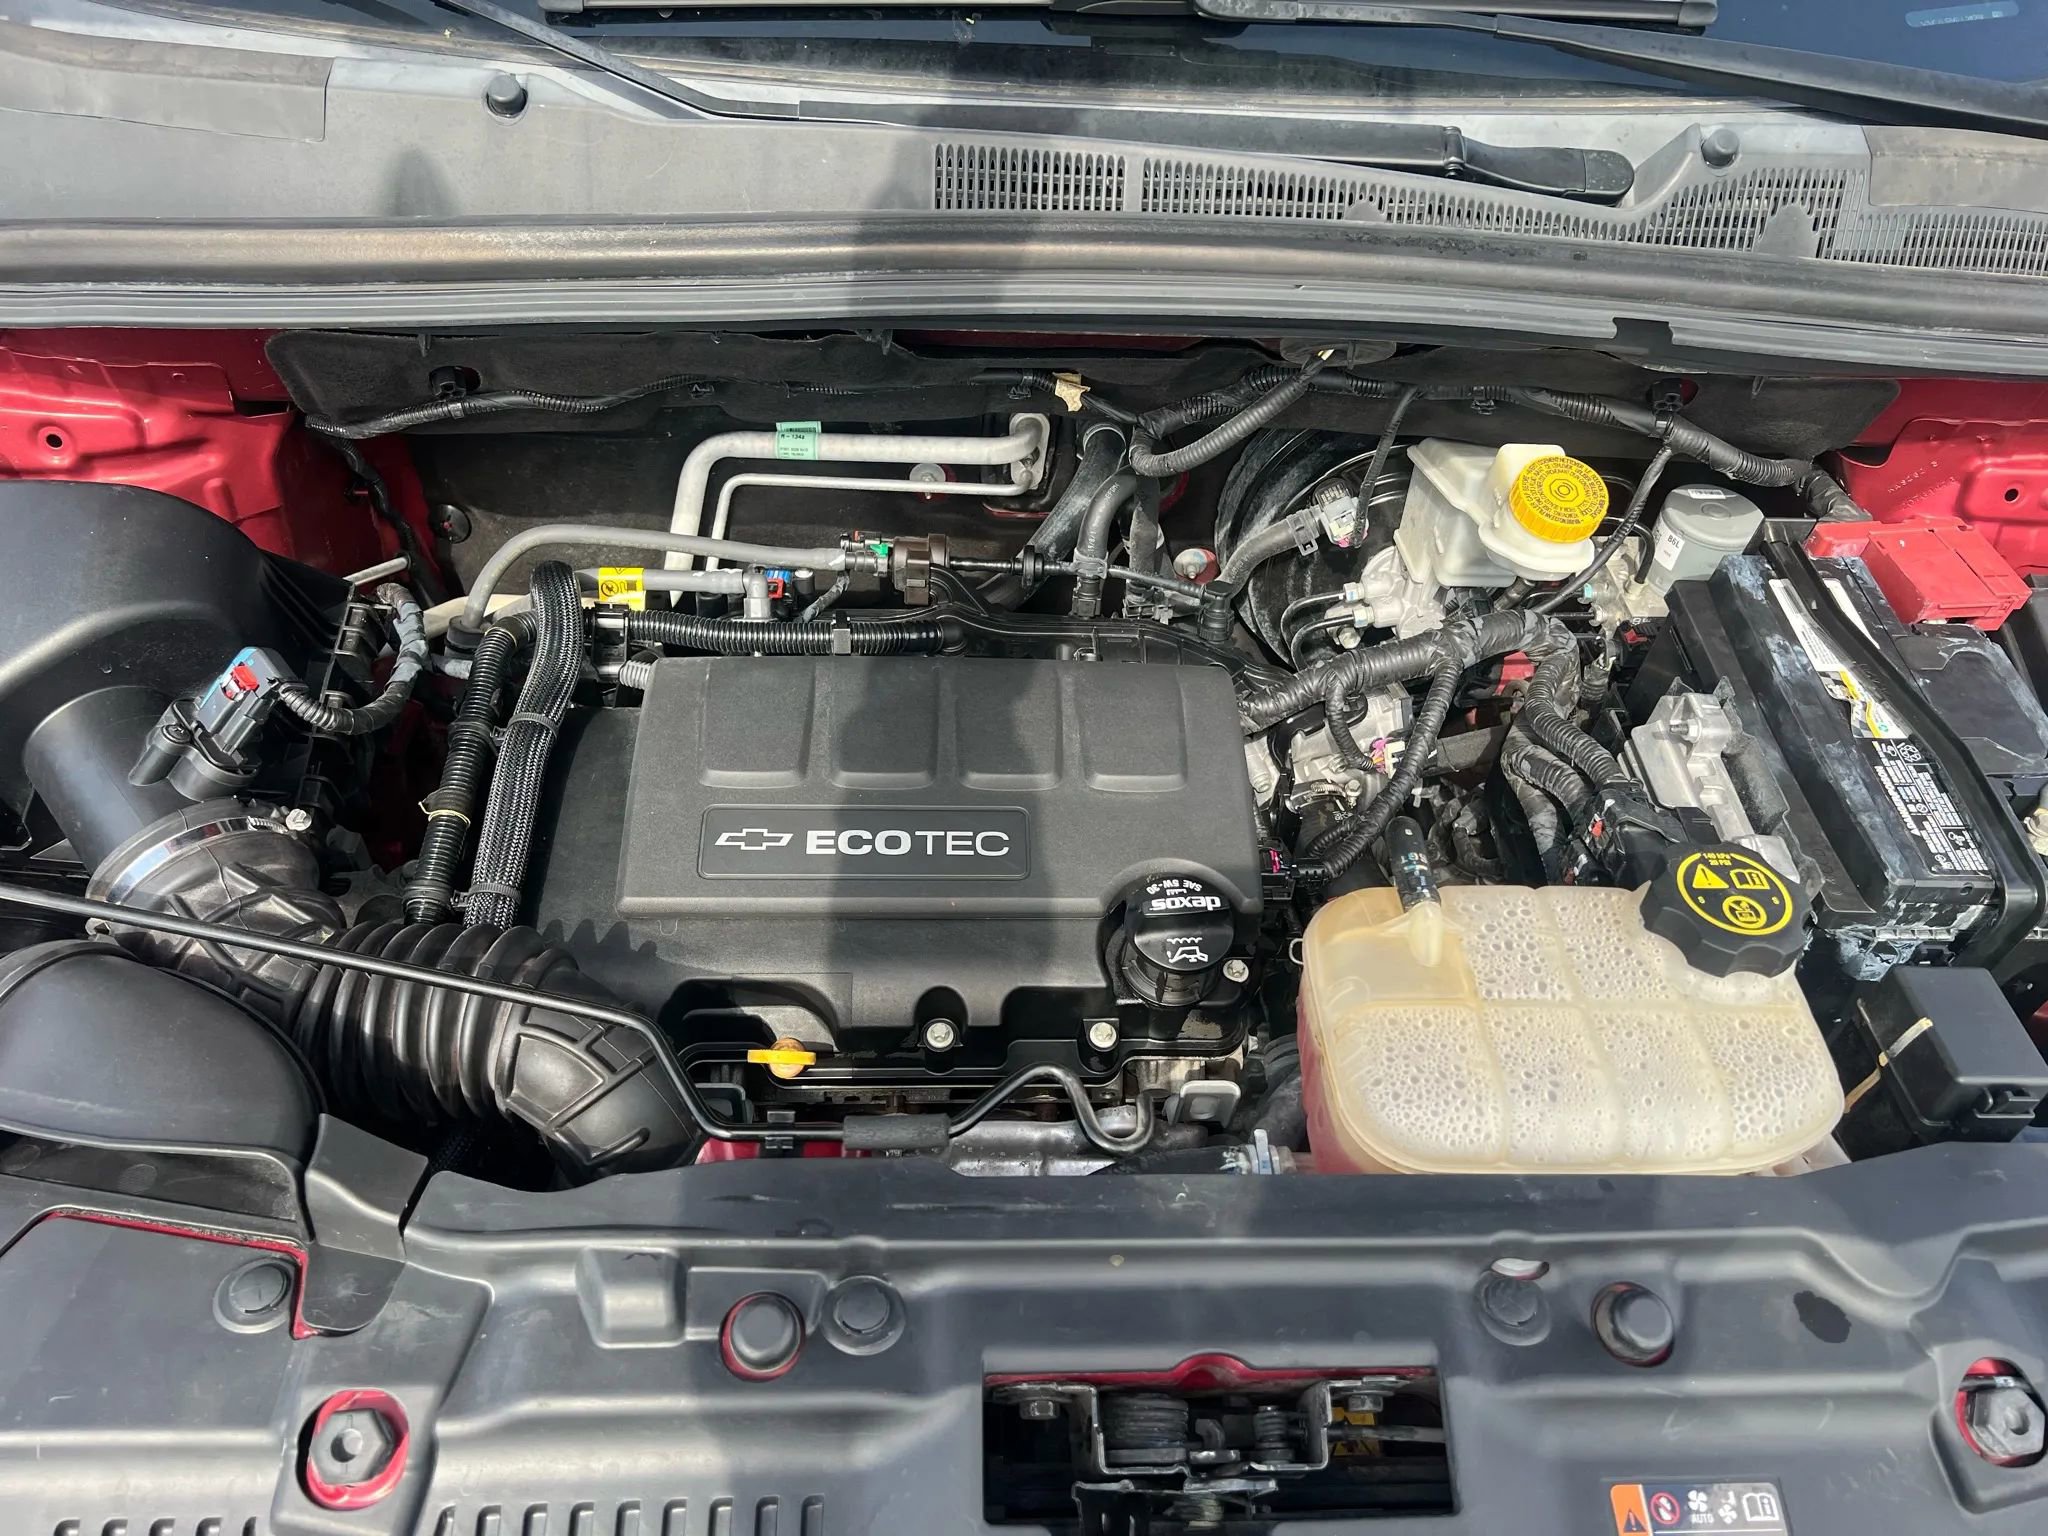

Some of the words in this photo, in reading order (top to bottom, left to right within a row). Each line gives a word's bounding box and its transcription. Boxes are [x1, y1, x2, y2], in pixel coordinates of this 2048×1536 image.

[806, 830, 1010, 857] ECOTEC
[1146, 879, 1180, 895] 5W-30
[1182, 879, 1203, 892] SAE
[1150, 896, 1221, 911] dexos
[1691, 1514, 1714, 1524] AUTO
